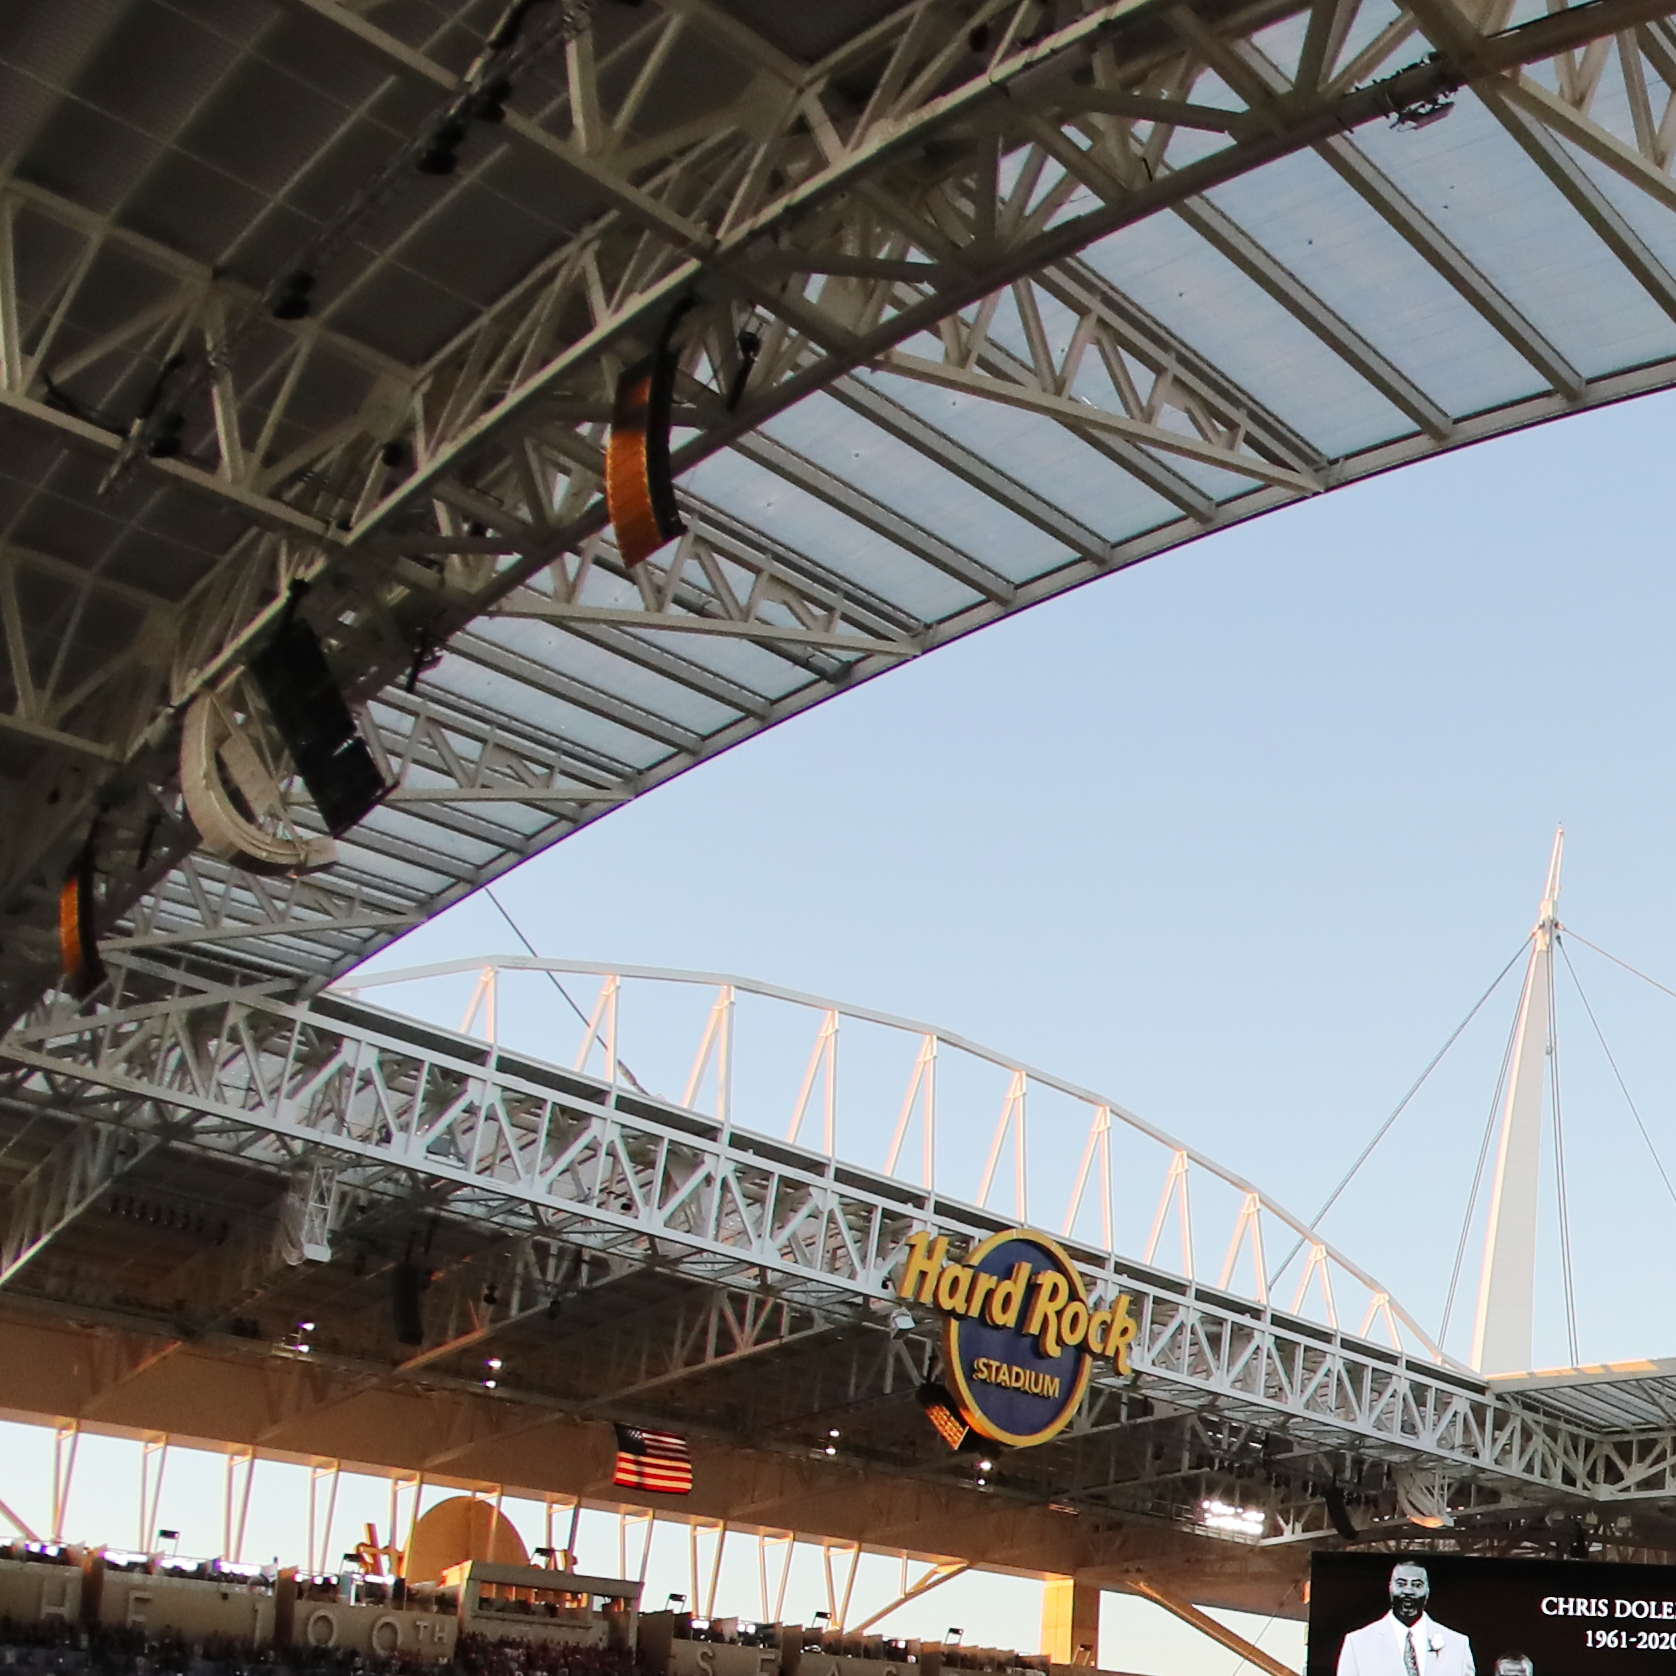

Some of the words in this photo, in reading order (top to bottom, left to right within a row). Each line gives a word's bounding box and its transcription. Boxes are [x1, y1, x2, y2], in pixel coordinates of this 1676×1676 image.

[900, 1230, 1032, 1328] Hard
[1022, 1270, 1138, 1376] Rock
[973, 1357, 1061, 1399] STADIUM
[1541, 1596, 1609, 1618] CHRIS
